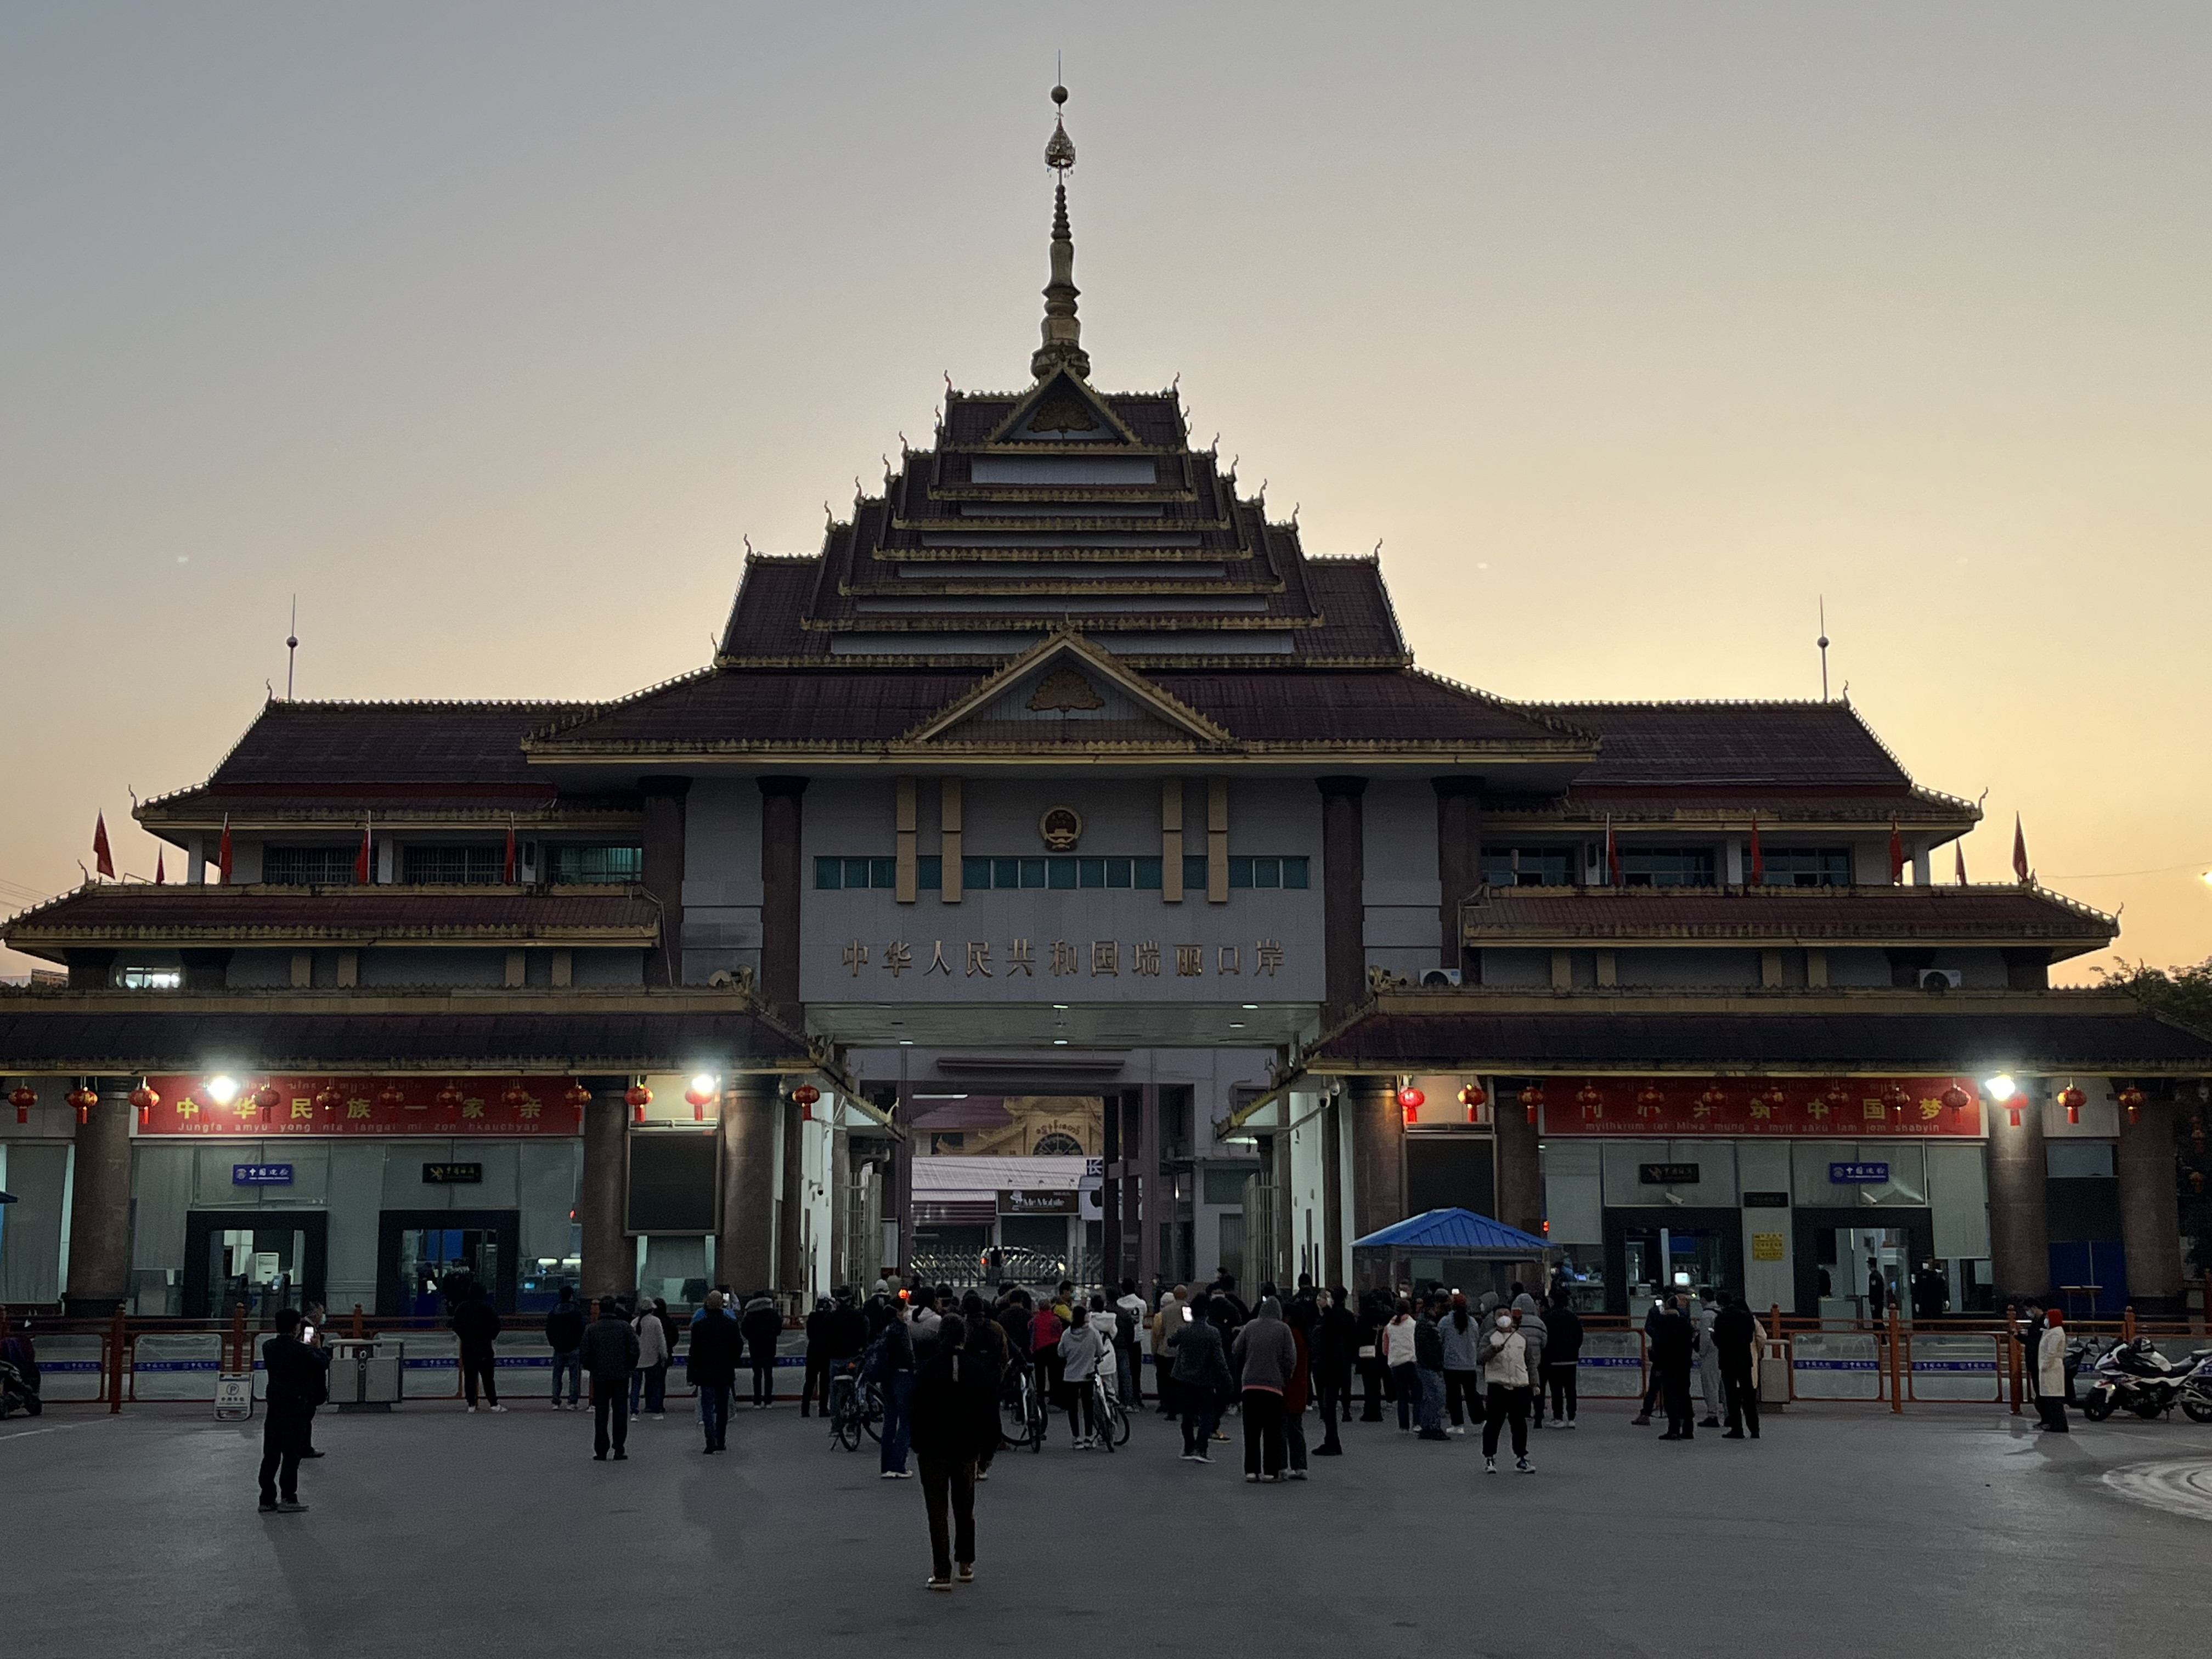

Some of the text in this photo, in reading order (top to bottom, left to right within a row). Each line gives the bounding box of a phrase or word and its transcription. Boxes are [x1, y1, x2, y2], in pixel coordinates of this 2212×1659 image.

[841, 938, 1285, 977] 中华人民共和国瑞丽口岸
[176, 1097, 541, 1119] 中华民族一家亲
[235, 1124, 268, 1132] amyu
[280, 1124, 311, 1133] yong
